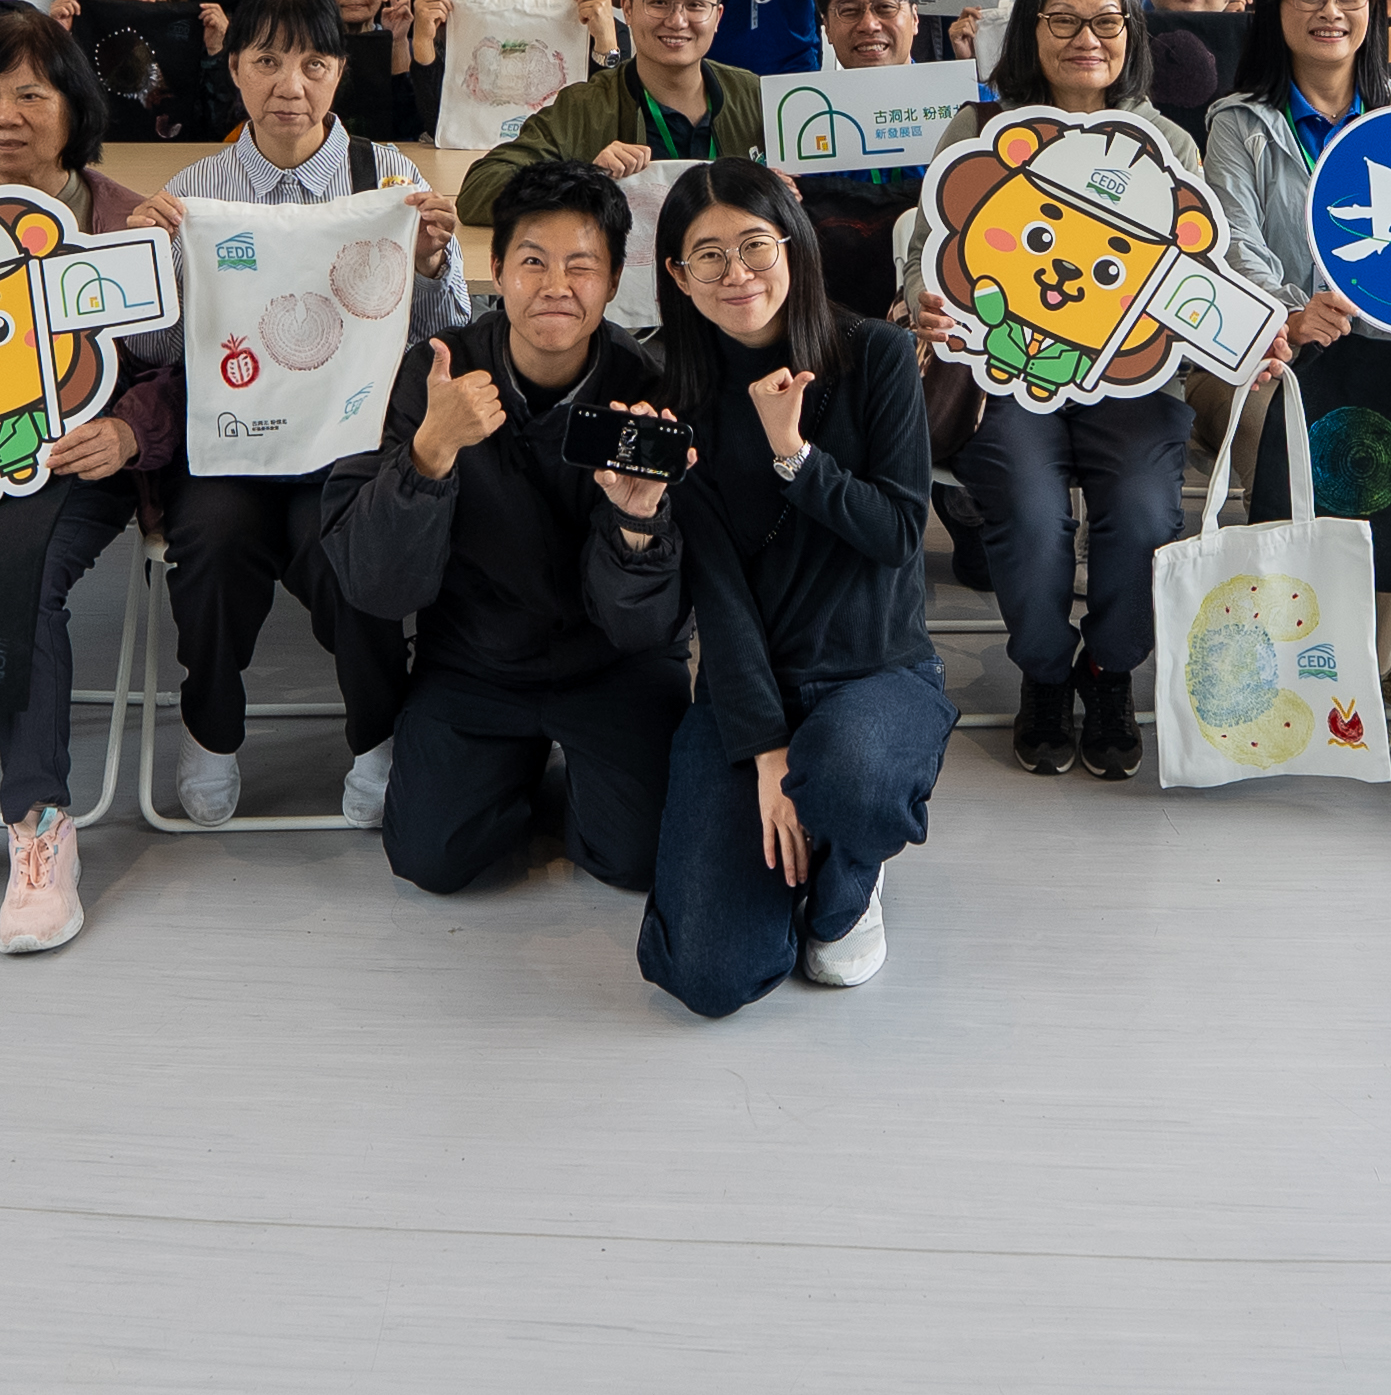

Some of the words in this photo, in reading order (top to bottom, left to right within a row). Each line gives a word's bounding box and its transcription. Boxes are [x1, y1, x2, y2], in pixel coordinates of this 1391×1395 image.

[873, 107, 918, 124] 古洞北
[1090, 171, 1126, 195] CEDD
[216, 246, 256, 259] CEDD
[1297, 655, 1337, 670] CEDD
